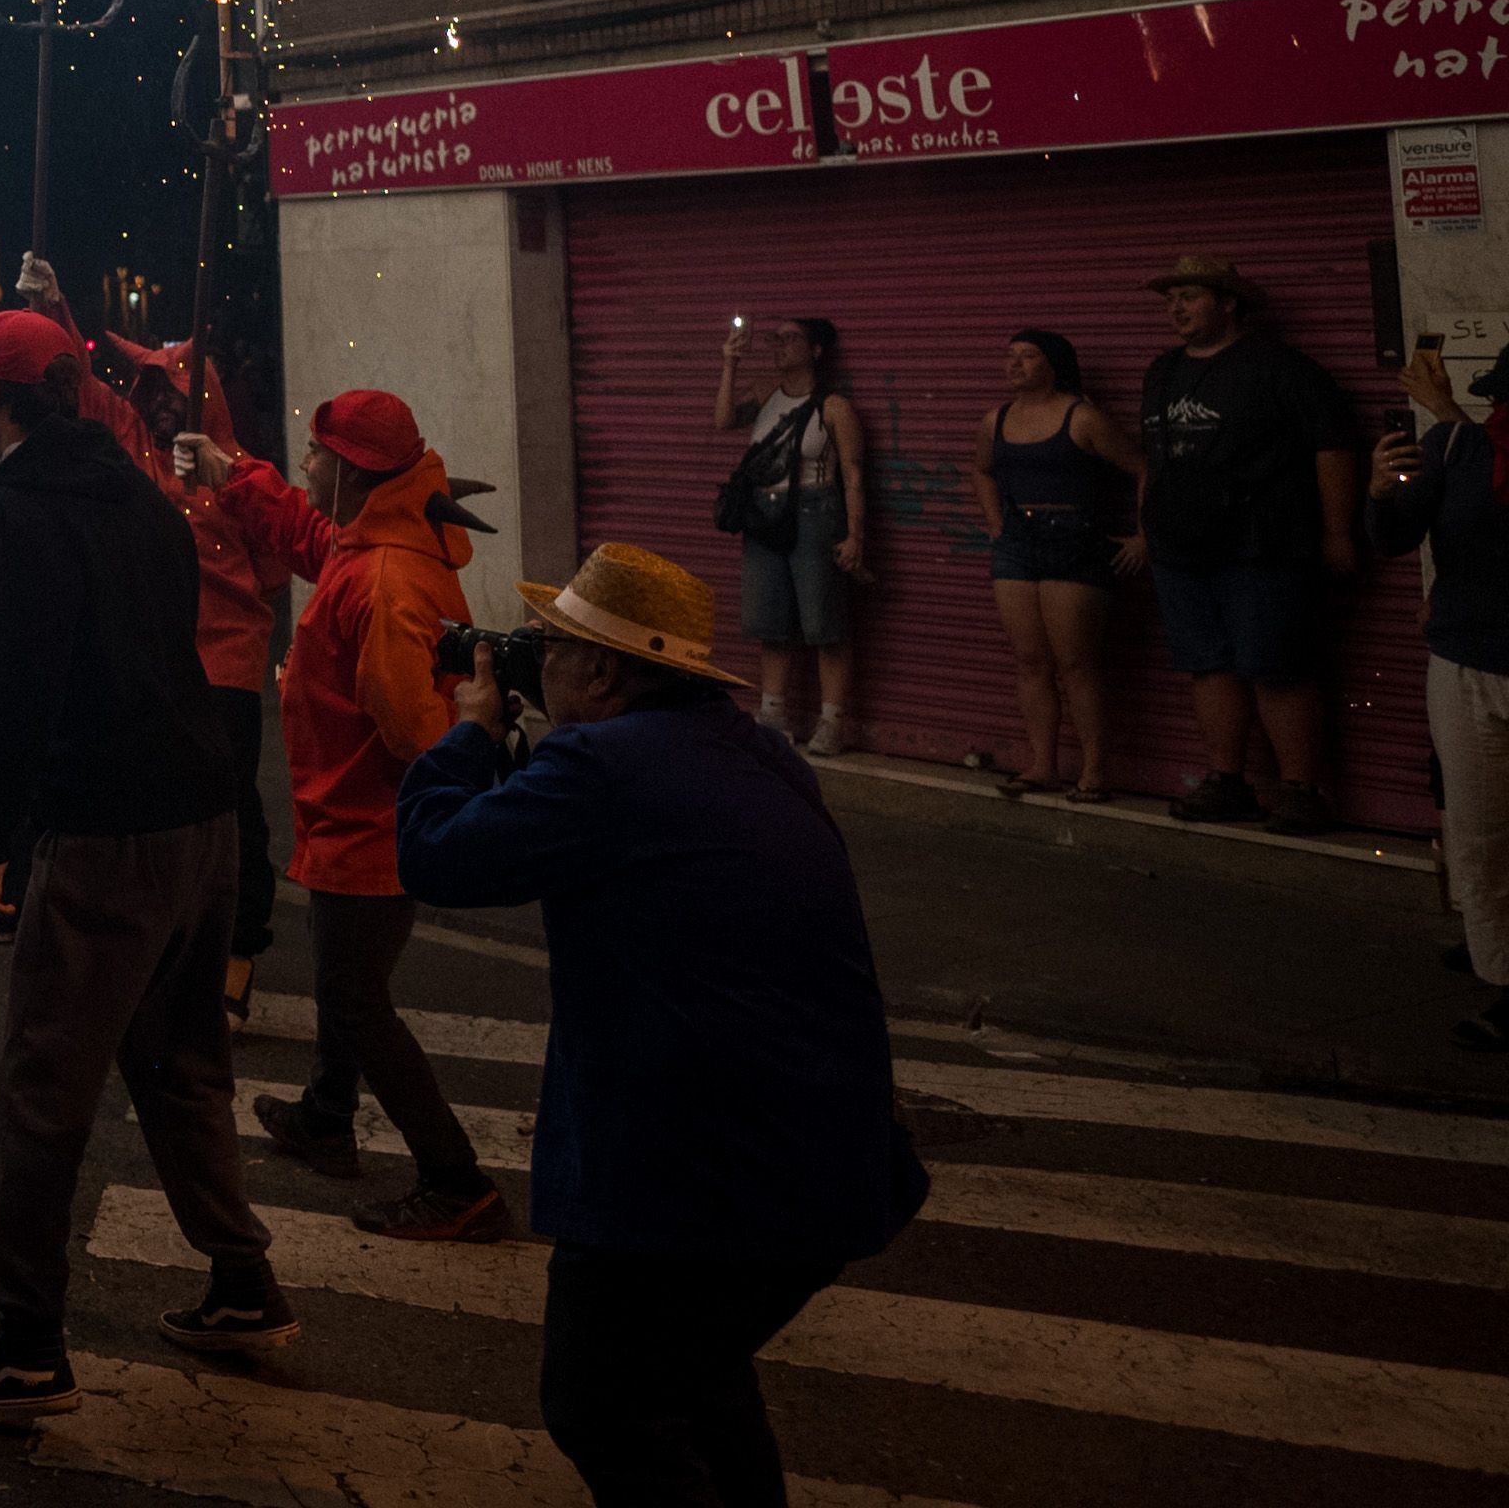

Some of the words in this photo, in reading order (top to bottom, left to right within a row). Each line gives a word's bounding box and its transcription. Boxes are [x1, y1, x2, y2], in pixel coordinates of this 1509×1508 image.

[304, 92, 477, 167] perruqueria
[1403, 142, 1471, 154] verisure
[332, 138, 471, 187] naturista
[479, 163, 514, 182] DONA
[530, 160, 564, 179] HOME
[576, 156, 614, 175] NENS
[1406, 171, 1475, 184] Alarma
[1451, 320, 1487, 340] SE
